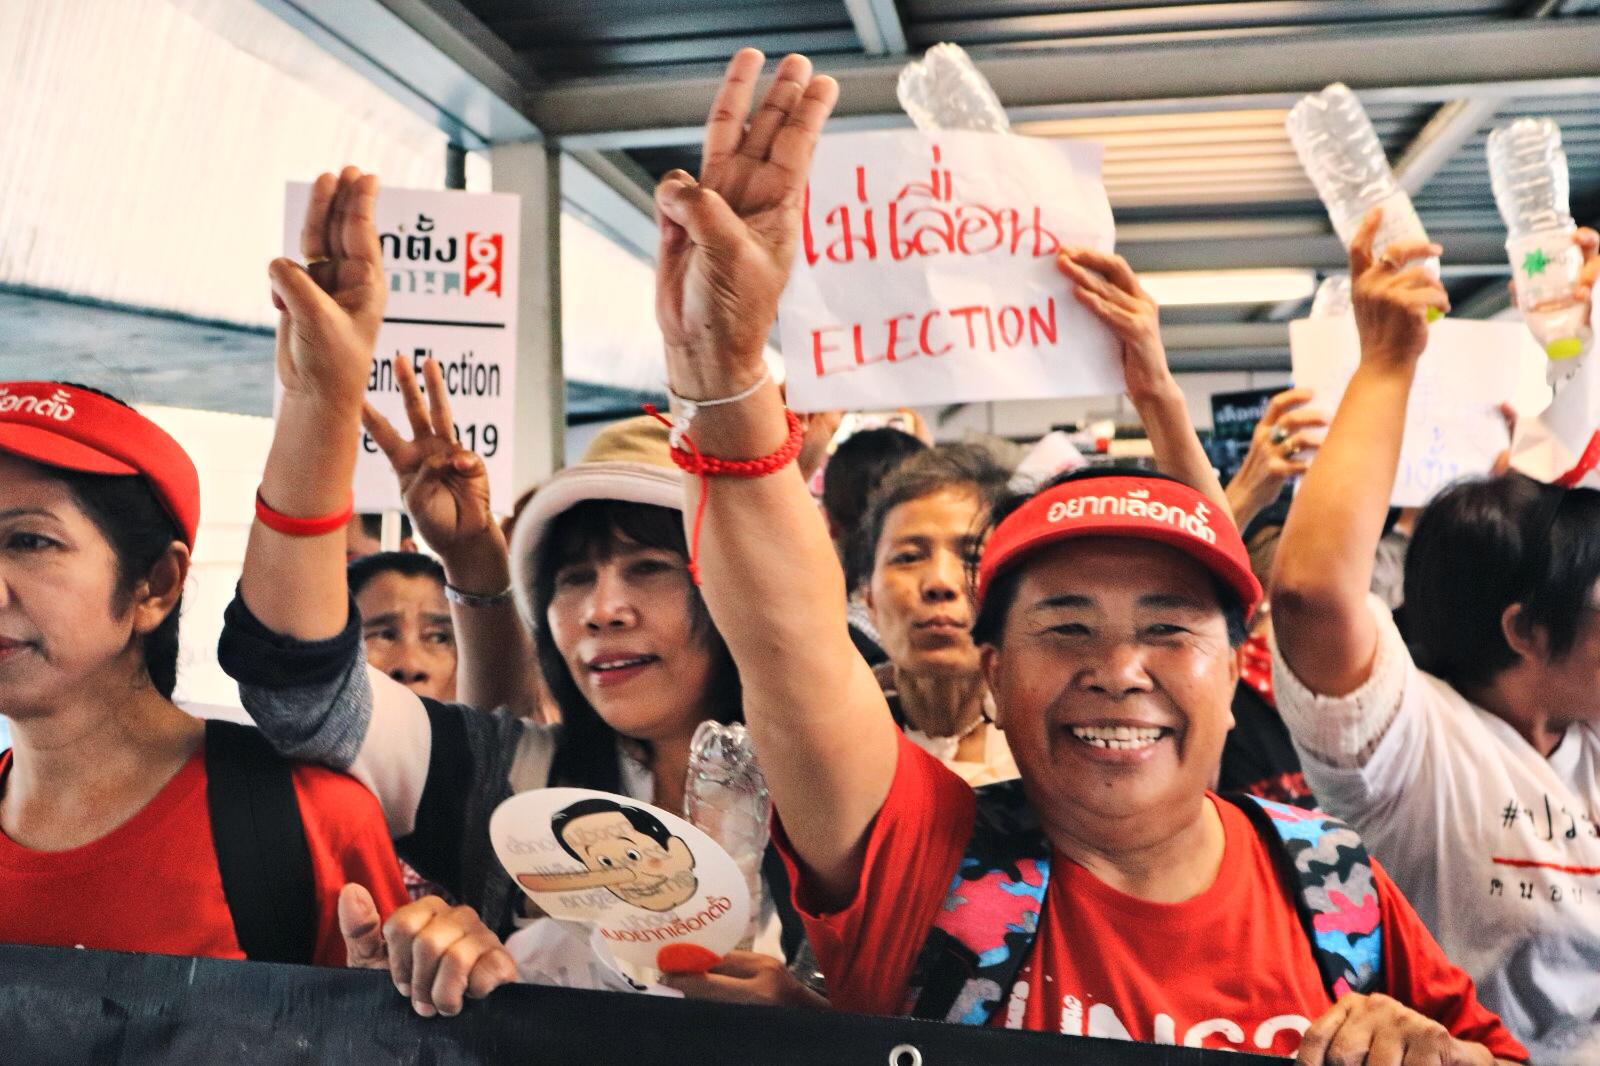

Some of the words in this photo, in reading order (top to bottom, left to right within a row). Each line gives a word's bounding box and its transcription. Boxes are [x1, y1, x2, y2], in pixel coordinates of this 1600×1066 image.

[380, 214, 457, 263] กตั้ง
[811, 297, 1057, 378] ELECTION
[413, 349, 500, 396] Ection
